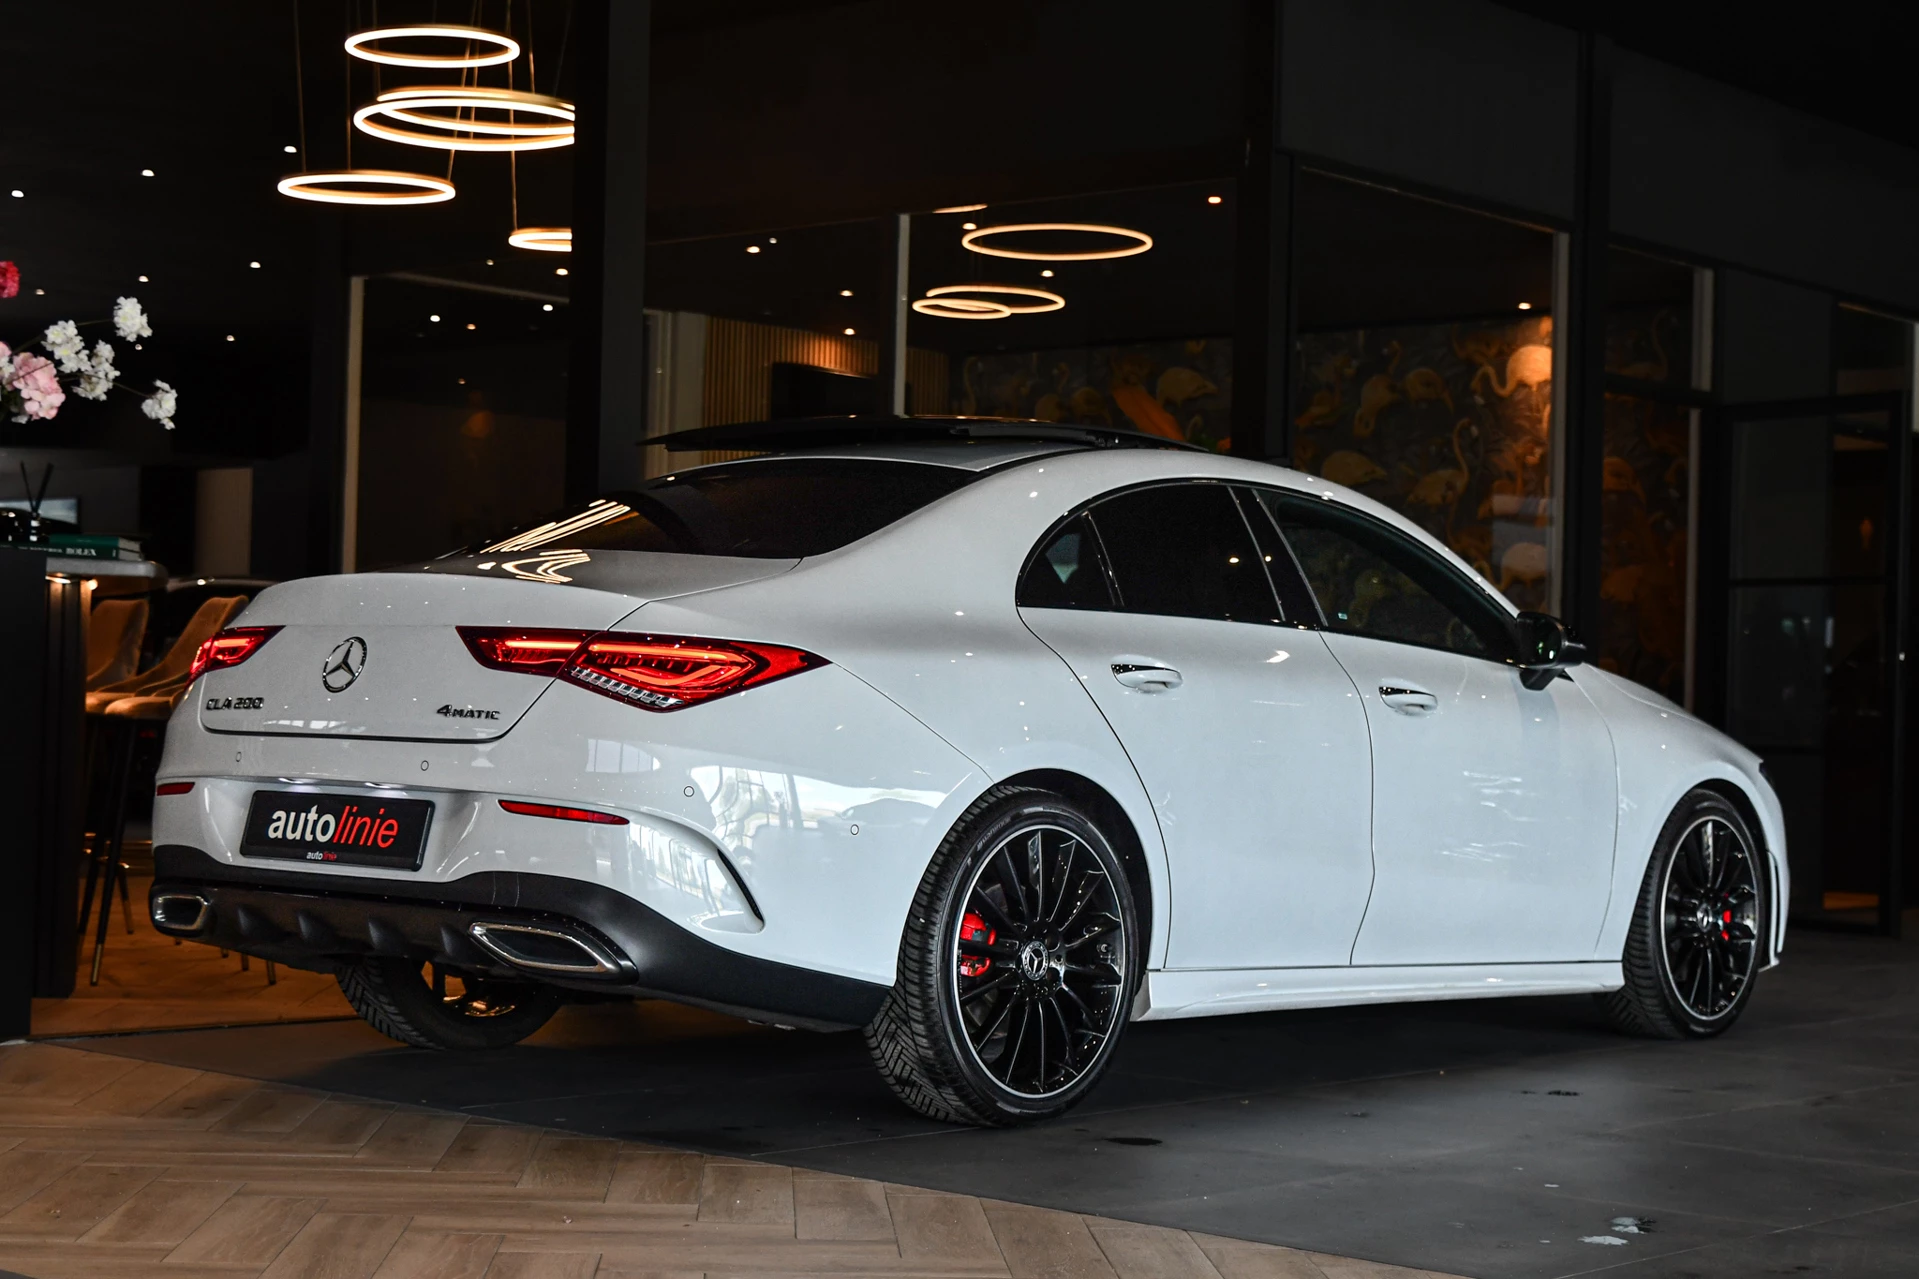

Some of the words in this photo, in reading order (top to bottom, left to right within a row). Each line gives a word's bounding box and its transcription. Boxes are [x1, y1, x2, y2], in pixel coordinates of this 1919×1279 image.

[65, 547, 97, 556] ROLEX
[206, 697, 232, 711] CLA
[233, 697, 265, 710] 200
[436, 704, 501, 720] 4MATIC
[267, 804, 399, 849] autolinie
[306, 850, 337, 861] autolinie
